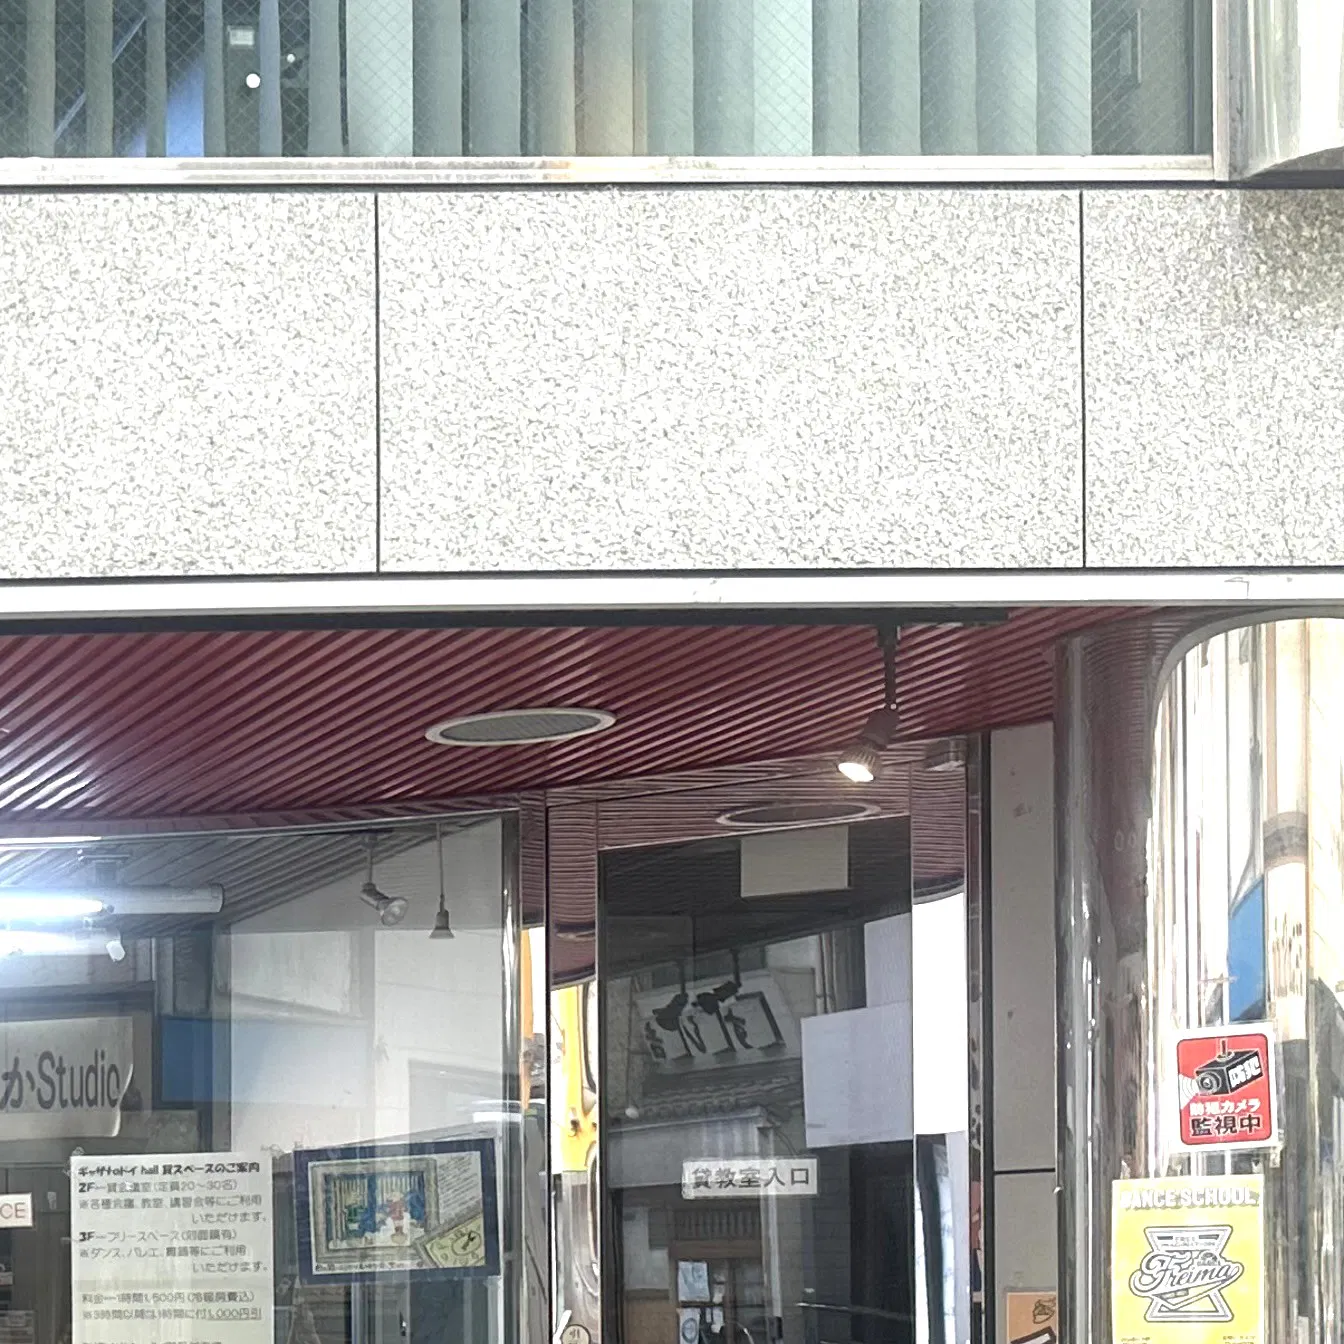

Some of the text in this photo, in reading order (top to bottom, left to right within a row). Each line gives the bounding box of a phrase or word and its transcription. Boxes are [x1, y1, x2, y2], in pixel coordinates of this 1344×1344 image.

[1191, 1114, 1261, 1136] 監視中
[692, 1166, 810, 1189] 貸教室入口
[1180, 1186, 1258, 1208] SCHOOL
